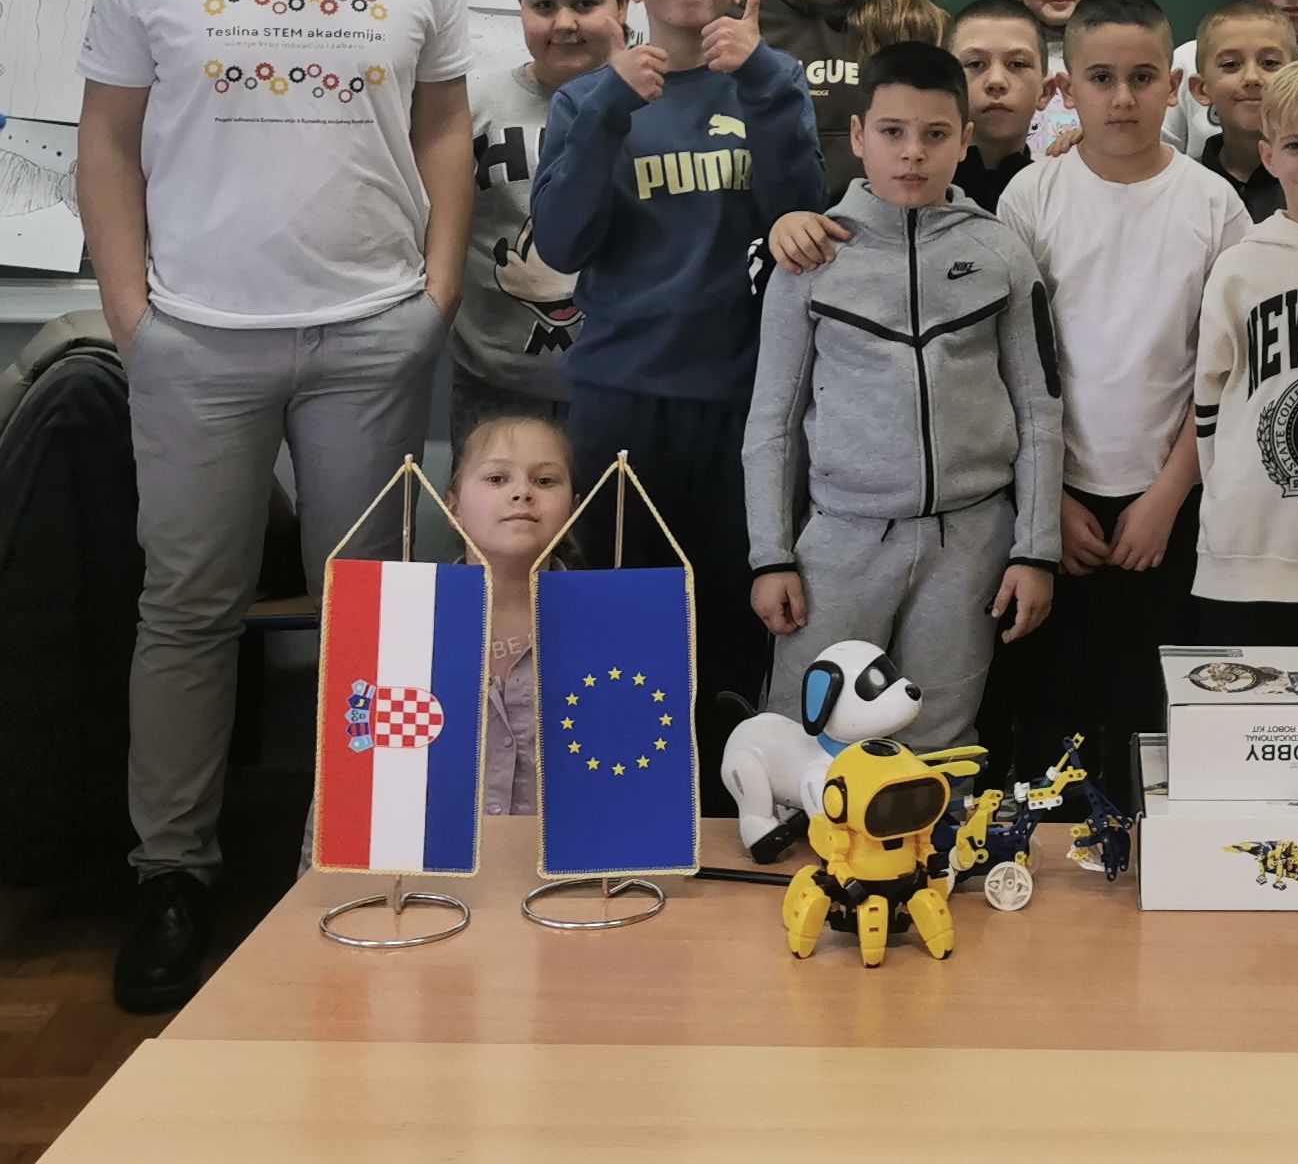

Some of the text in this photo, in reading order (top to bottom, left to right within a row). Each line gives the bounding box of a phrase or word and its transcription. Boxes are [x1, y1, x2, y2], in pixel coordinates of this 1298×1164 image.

[206, 25, 259, 37] Teslina
[263, 27, 302, 38] STEM
[798, 59, 859, 85] GUE
[634, 148, 752, 200] PUMA
[1276, 431, 1296, 475] STATE
